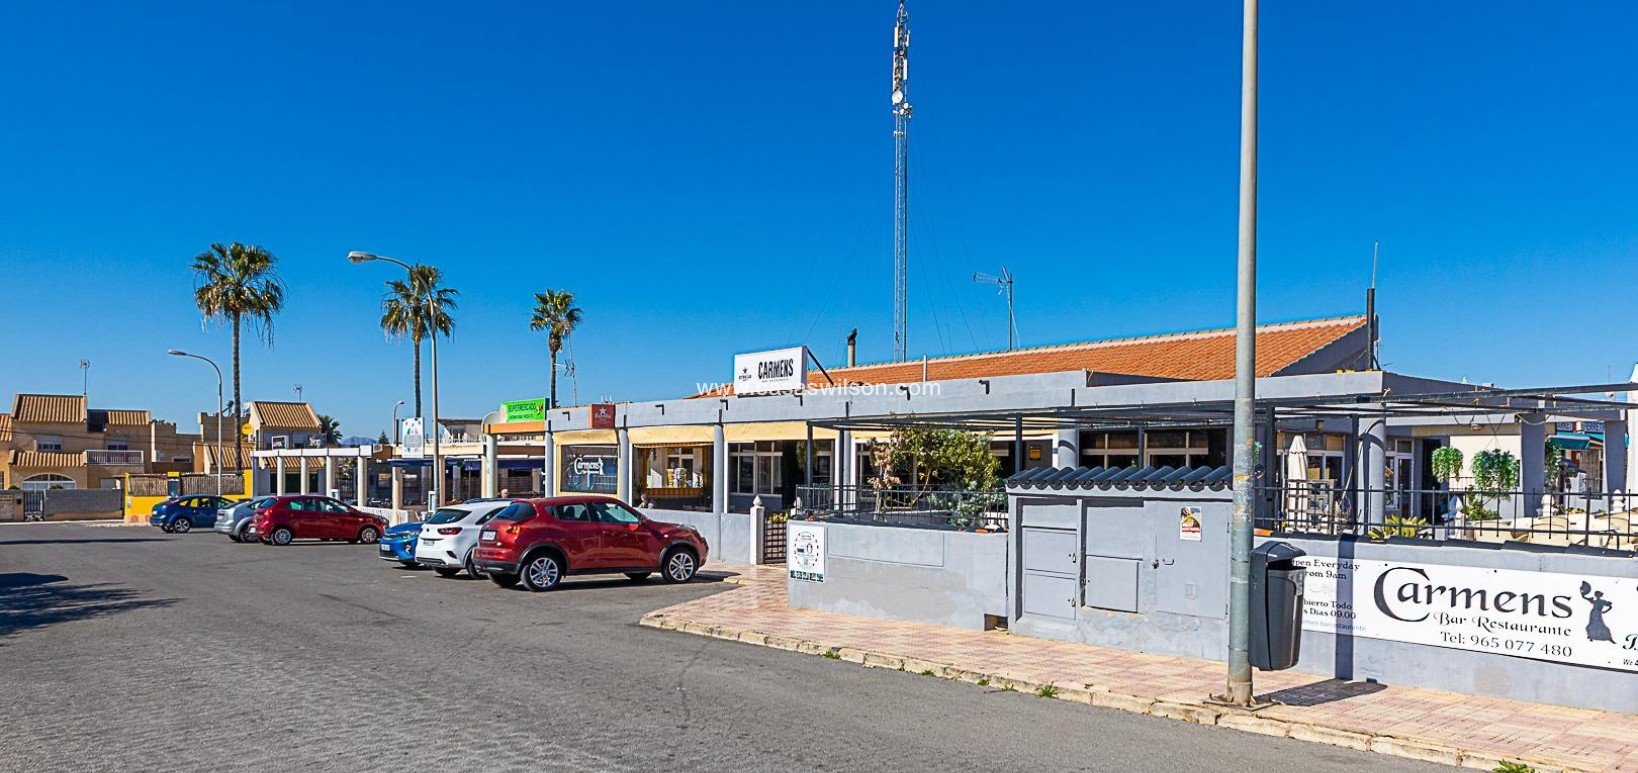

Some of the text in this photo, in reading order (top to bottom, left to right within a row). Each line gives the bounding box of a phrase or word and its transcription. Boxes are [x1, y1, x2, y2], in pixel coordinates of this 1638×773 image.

[758, 359, 794, 379] CARMENS
[508, 402, 536, 412] SUPERMERCADO
[1313, 559, 1360, 571] Everyday
[1304, 570, 1347, 579] rom 9am
[1373, 566, 1573, 623] Carmens
[1303, 599, 1352, 610] bierto Todo
[1330, 609, 1356, 620] 09.00
[1433, 612, 1572, 636] Bar Restaurante
[1440, 631, 1573, 657] Tel: 965 077 480
